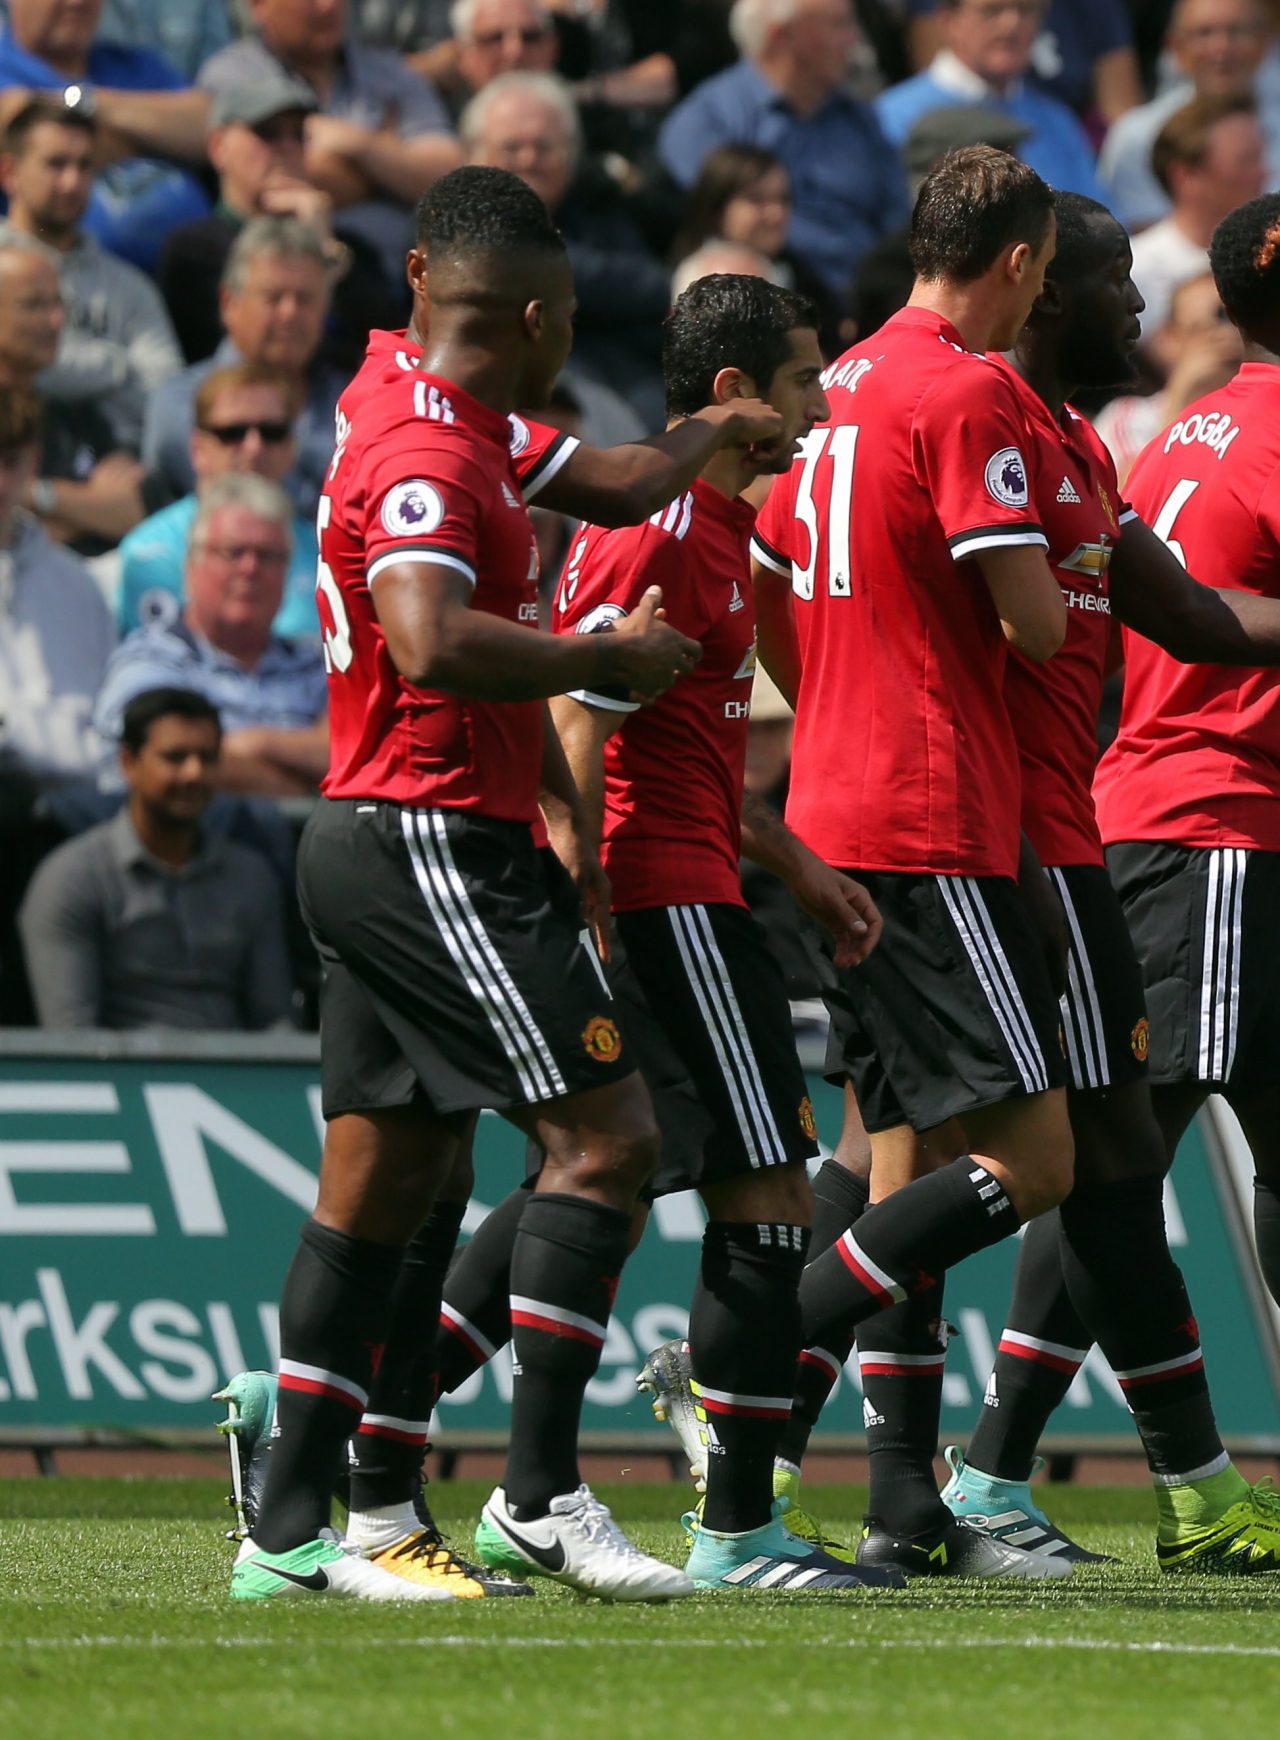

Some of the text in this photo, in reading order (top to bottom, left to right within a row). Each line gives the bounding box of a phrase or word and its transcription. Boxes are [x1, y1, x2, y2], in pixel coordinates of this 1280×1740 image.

[1164, 411, 1240, 460] POGBA
[792, 424, 861, 602] 31
[1056, 493, 1082, 504] adidas
[725, 701, 751, 719] CH
